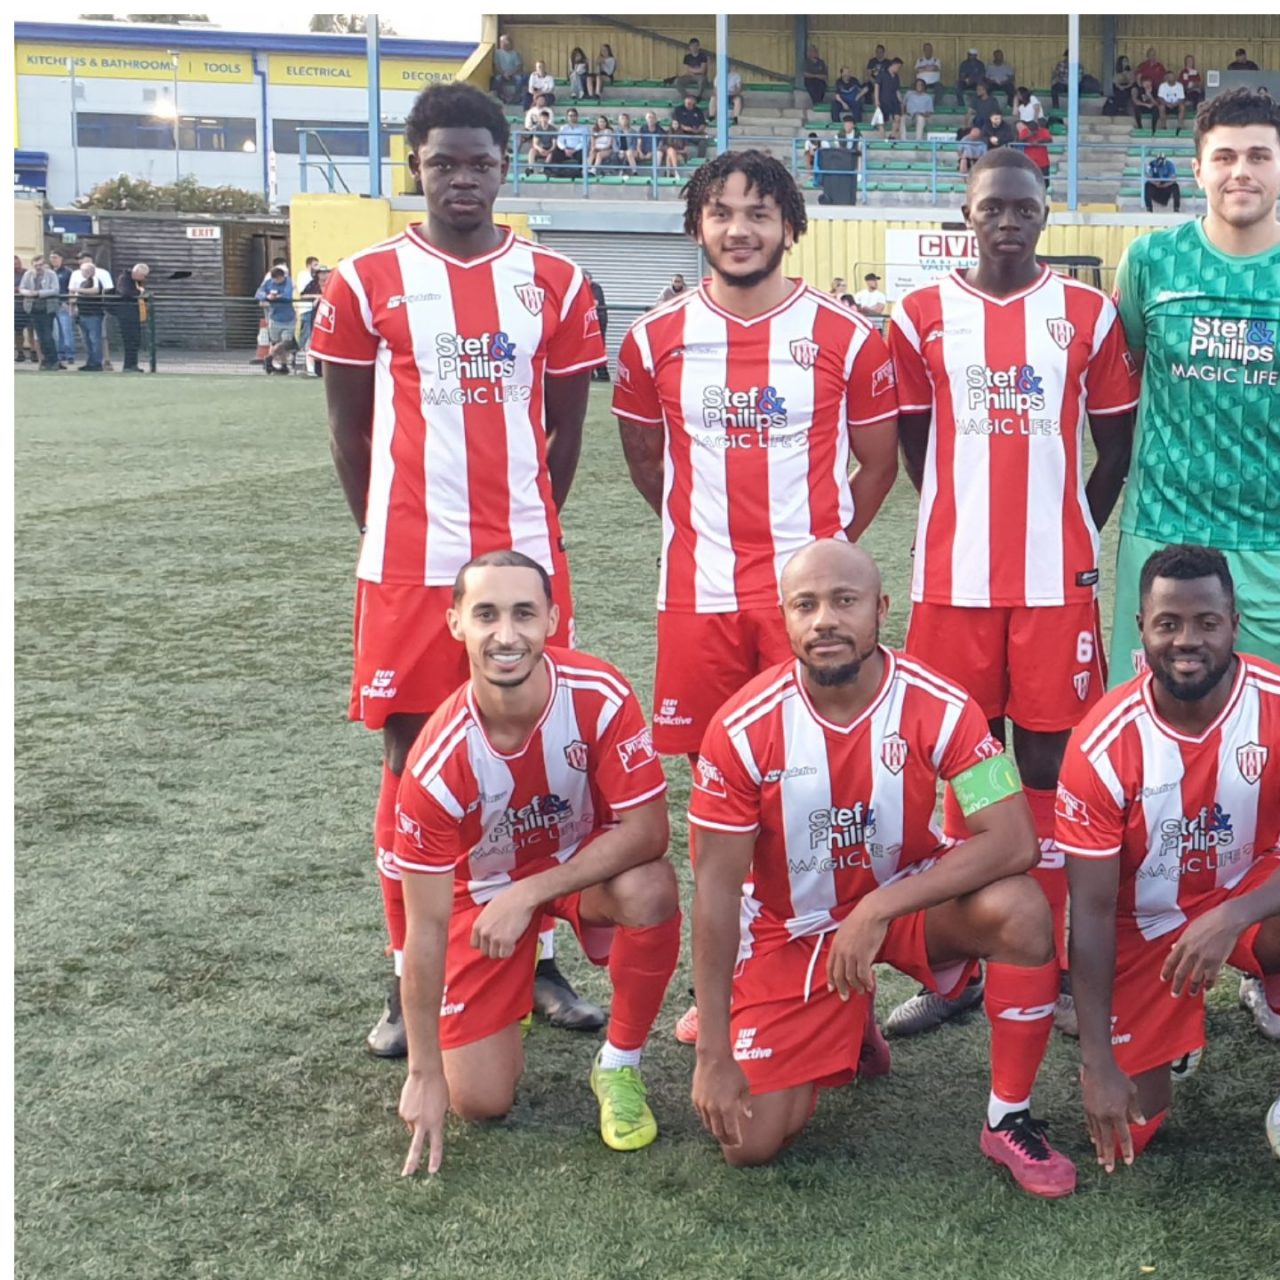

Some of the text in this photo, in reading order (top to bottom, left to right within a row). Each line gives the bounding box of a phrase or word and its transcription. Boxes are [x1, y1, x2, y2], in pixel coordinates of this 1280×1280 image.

[89, 58, 98, 68] &
[203, 62, 242, 74] TOOLS
[286, 65, 353, 79] ELECTRICAL
[401, 70, 457, 82] DECORAT
[191, 228, 215, 237] EXIT
[1190, 335, 1274, 365] Philips
[437, 356, 515, 383] Philips
[1171, 363, 1279, 386] MAGIC LIFE
[968, 389, 1045, 415] Philips
[702, 408, 788, 432] Philips
[1076, 631, 1093, 663] 6
[788, 850, 862, 875] MAGIC
